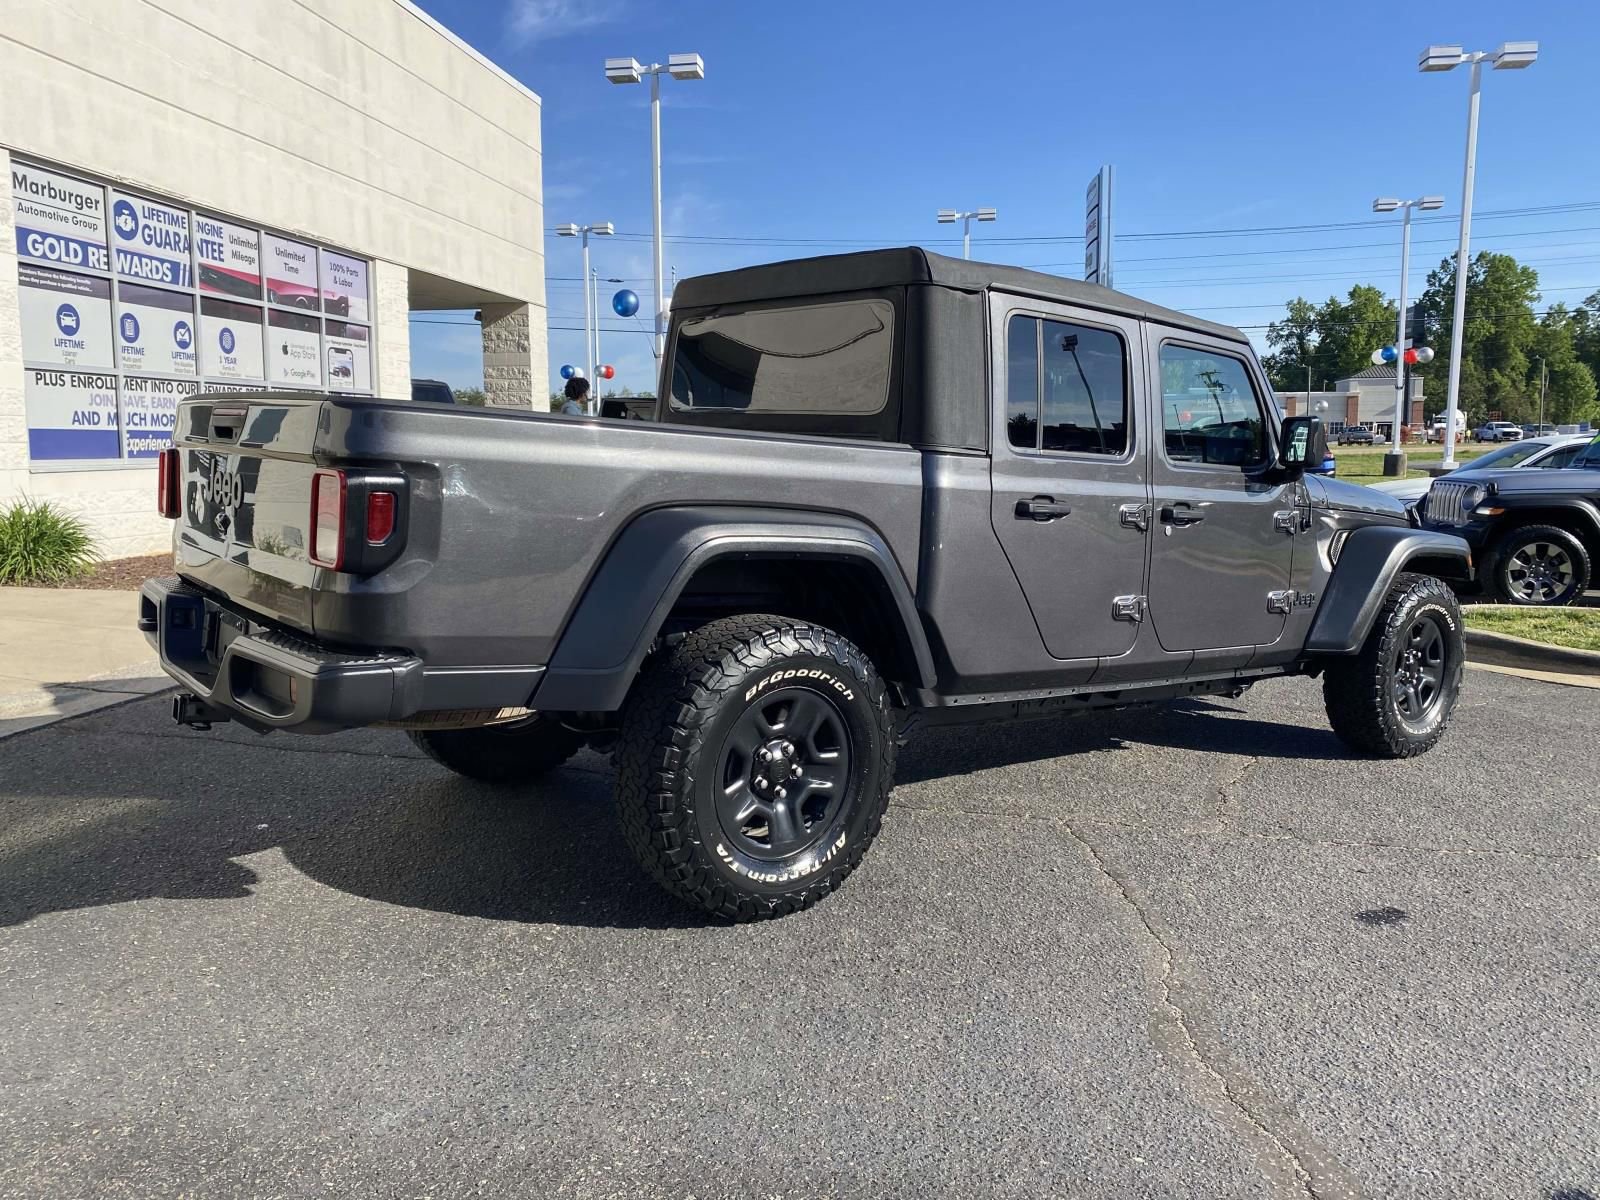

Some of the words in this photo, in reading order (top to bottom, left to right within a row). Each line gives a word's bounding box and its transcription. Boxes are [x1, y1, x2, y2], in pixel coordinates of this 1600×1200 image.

[12, 171, 100, 211] Marburger
[17, 202, 70, 224] Automotive
[71, 215, 98, 232] Group
[141, 205, 187, 230] LIFETIME
[27, 233, 83, 264] GOLD
[229, 234, 258, 251] Unlimited
[231, 249, 256, 265] Mileage
[275, 246, 306, 263] Unlimited
[283, 262, 299, 275] Time
[329, 261, 345, 274] 100%
[346, 268, 359, 277] Parts
[333, 275, 338, 284] &
[339, 276, 353, 288] Labor
[54, 338, 86, 350] LIFETIME
[121, 345, 145, 356] IFETIME
[171, 351, 195, 361] LIFETIME
[223, 356, 237, 365] YEAR
[35, 372, 66, 387] PLUS
[151, 381, 174, 394] INTO
[176, 382, 197, 395] OUR
[151, 396, 176, 409] EARN
[72, 410, 101, 426] AND
[151, 413, 176, 427] MOR
[205, 458, 243, 510] Jeep
[1292, 591, 1316, 608] Jeep
[745, 667, 855, 702] BFGoodrich
[747, 830, 846, 883] All-Terrain
